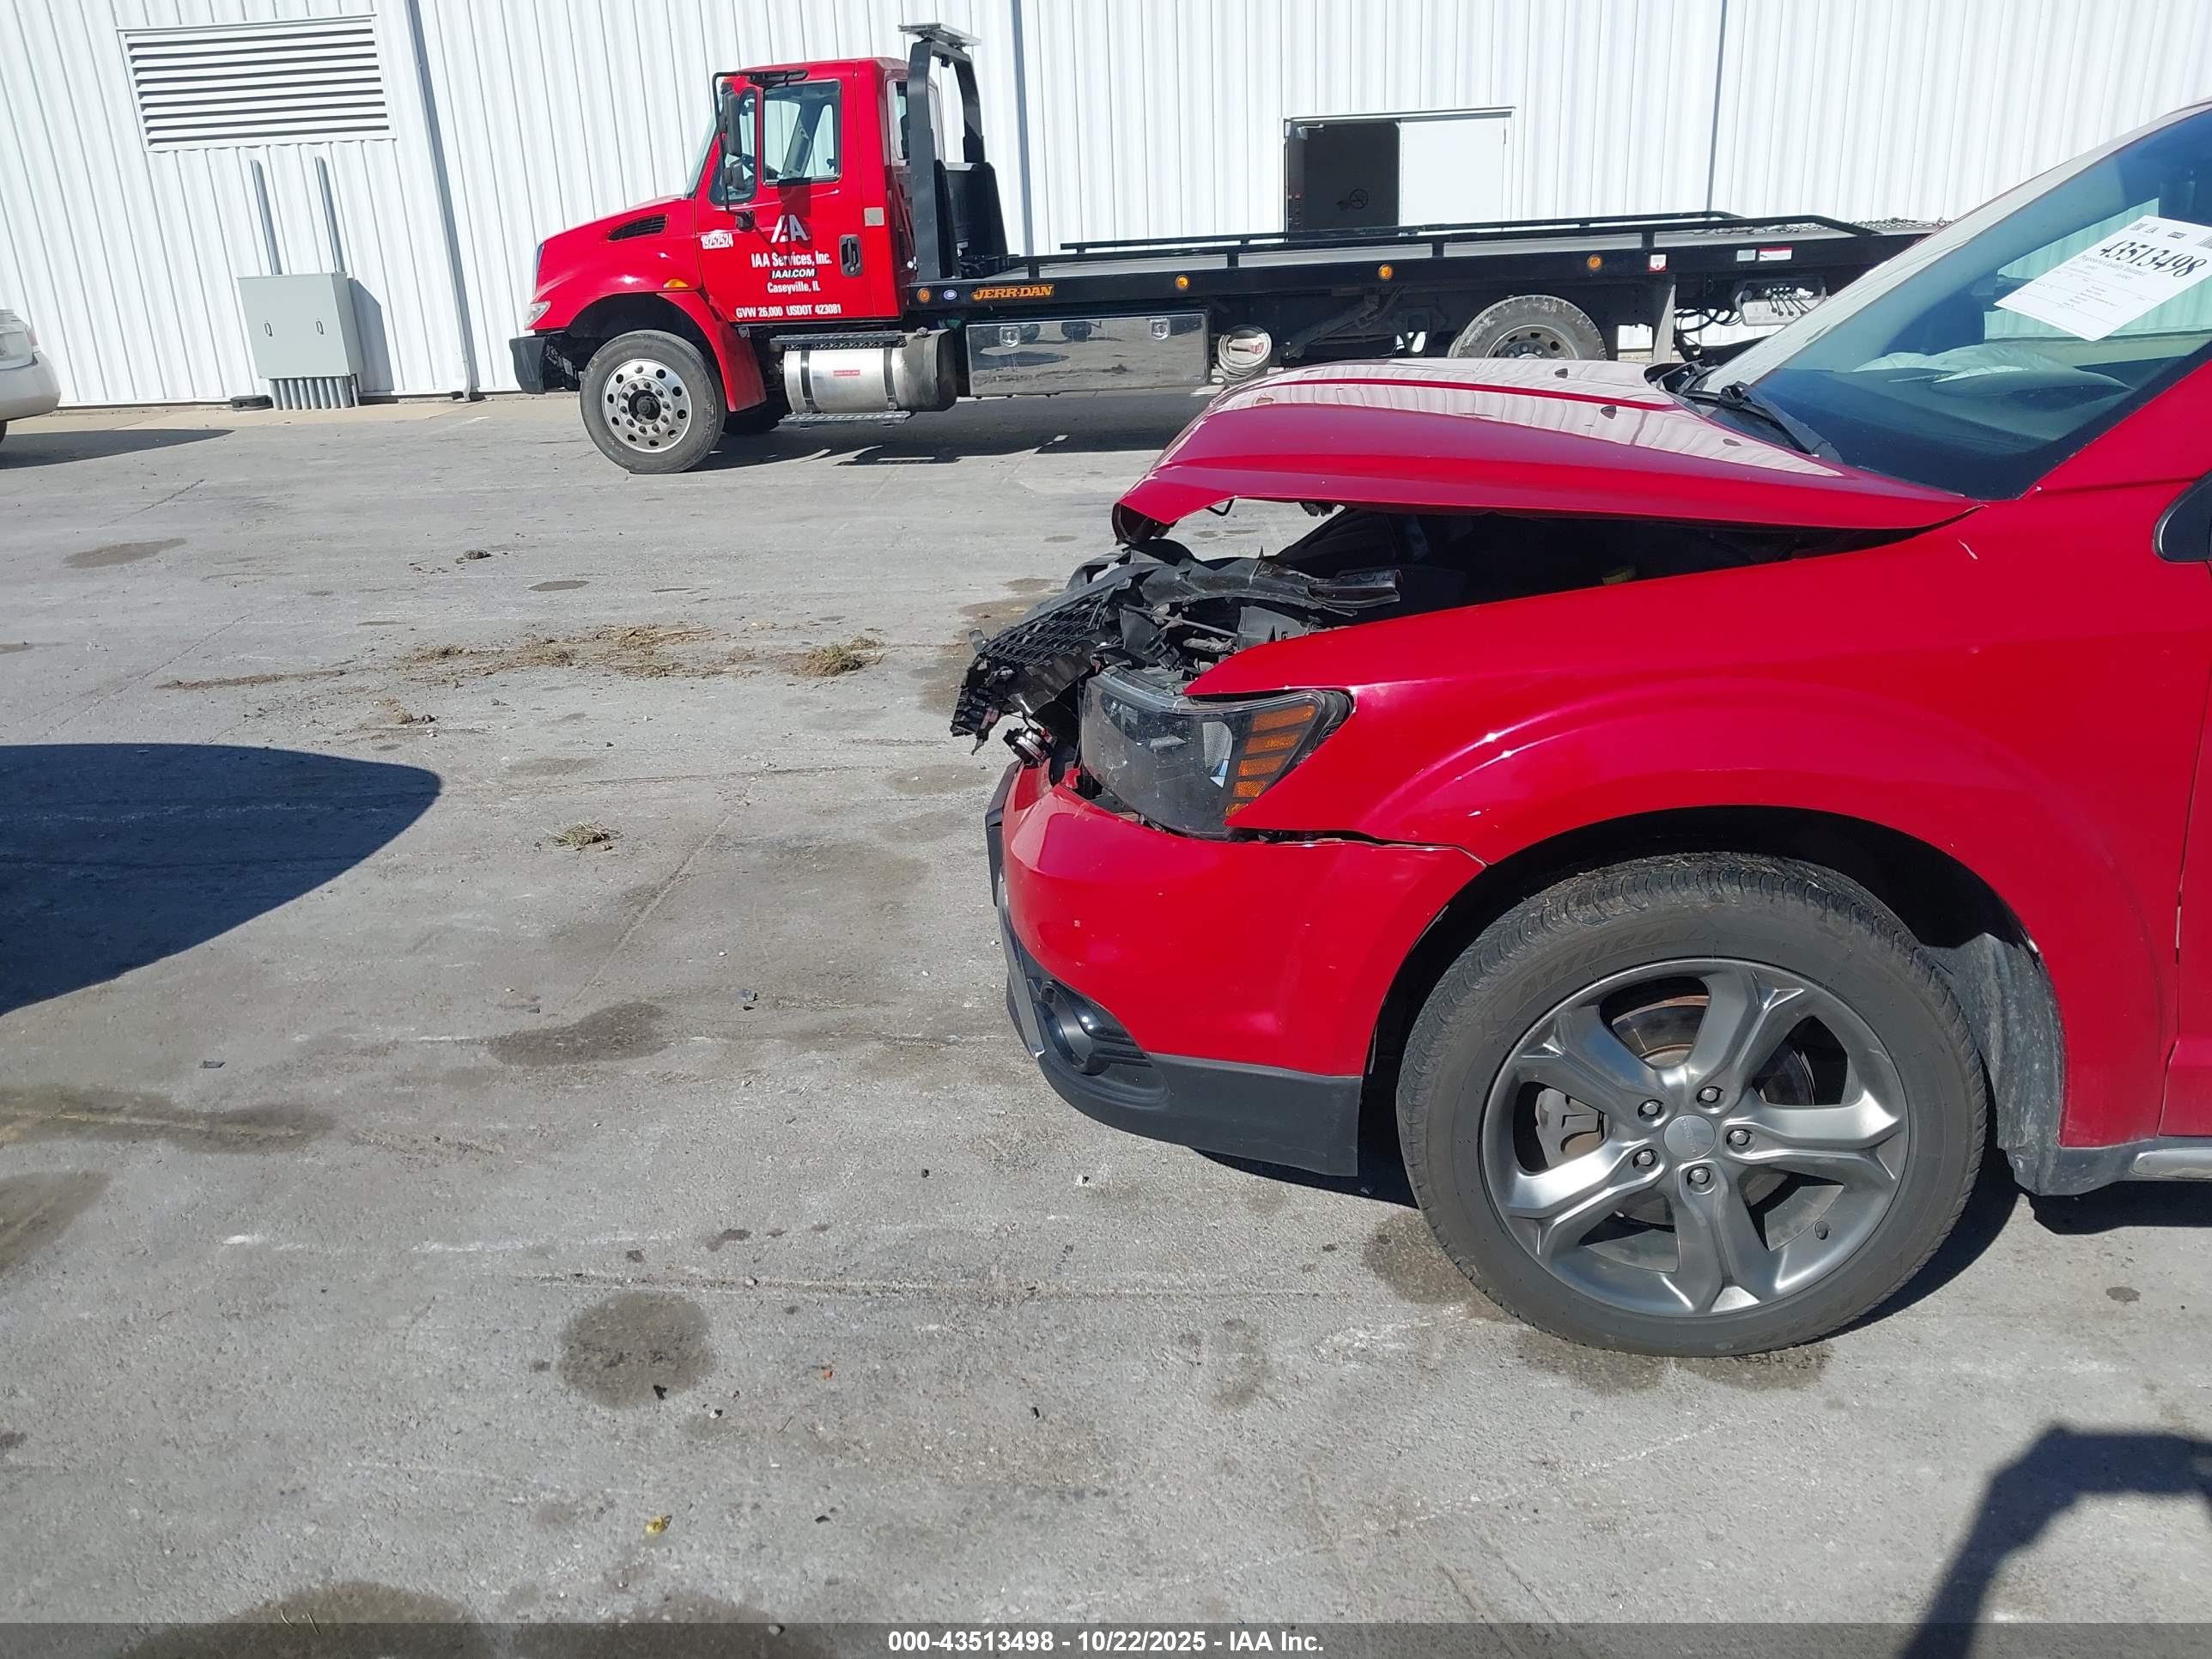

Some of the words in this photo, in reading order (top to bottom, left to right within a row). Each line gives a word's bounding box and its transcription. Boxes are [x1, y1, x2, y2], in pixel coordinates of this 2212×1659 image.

[750, 252, 770, 268] IAA
[771, 252, 814, 267] Services,
[815, 250, 832, 264] Inc.
[2100, 240, 2207, 277] 43513498
[772, 268, 815, 279] IAAI.COM
[767, 281, 811, 295] Caseyville,
[811, 280, 821, 292] IL
[736, 307, 756, 318] GVW
[757, 306, 783, 318] 26,000
[786, 304, 812, 316] USDOT
